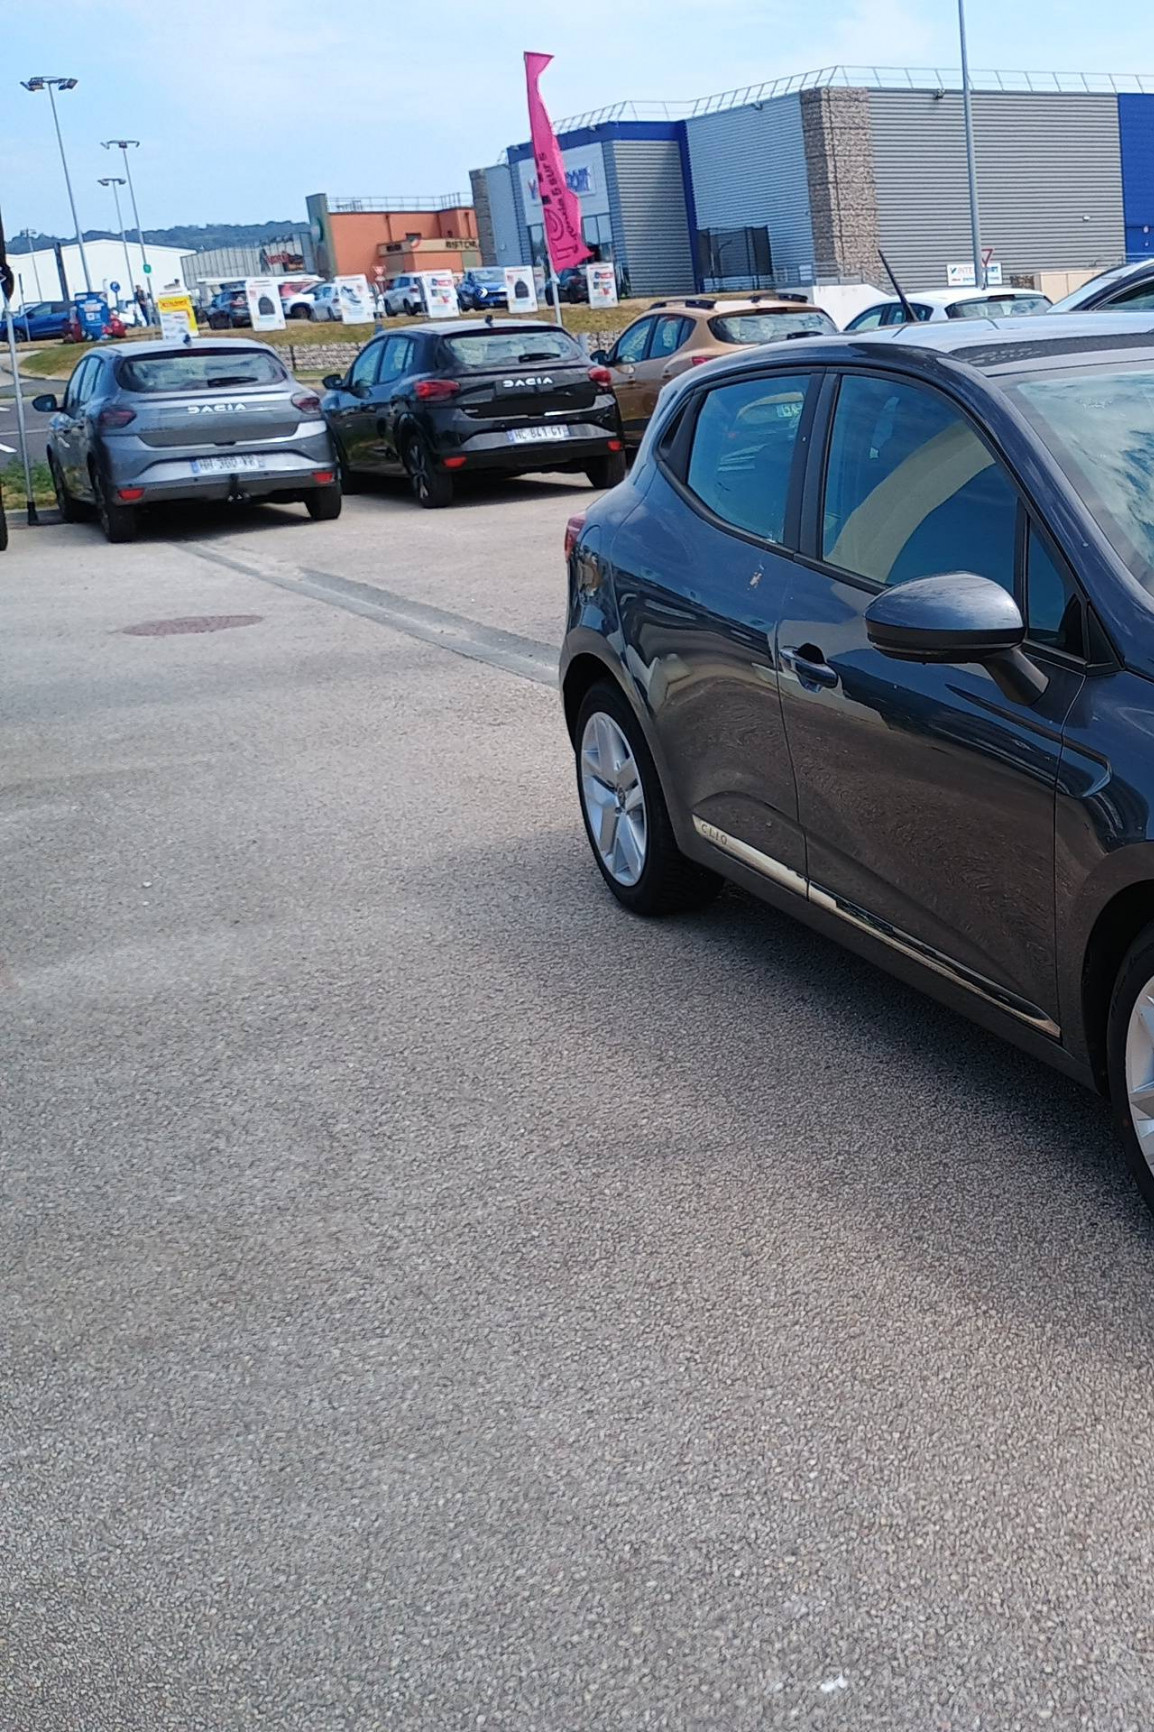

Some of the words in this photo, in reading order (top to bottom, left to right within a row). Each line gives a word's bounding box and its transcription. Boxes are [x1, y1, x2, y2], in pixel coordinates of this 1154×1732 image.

[502, 376, 554, 388] DACIA
[187, 402, 247, 414] DACIA
[701, 823, 728, 845] CLIO
